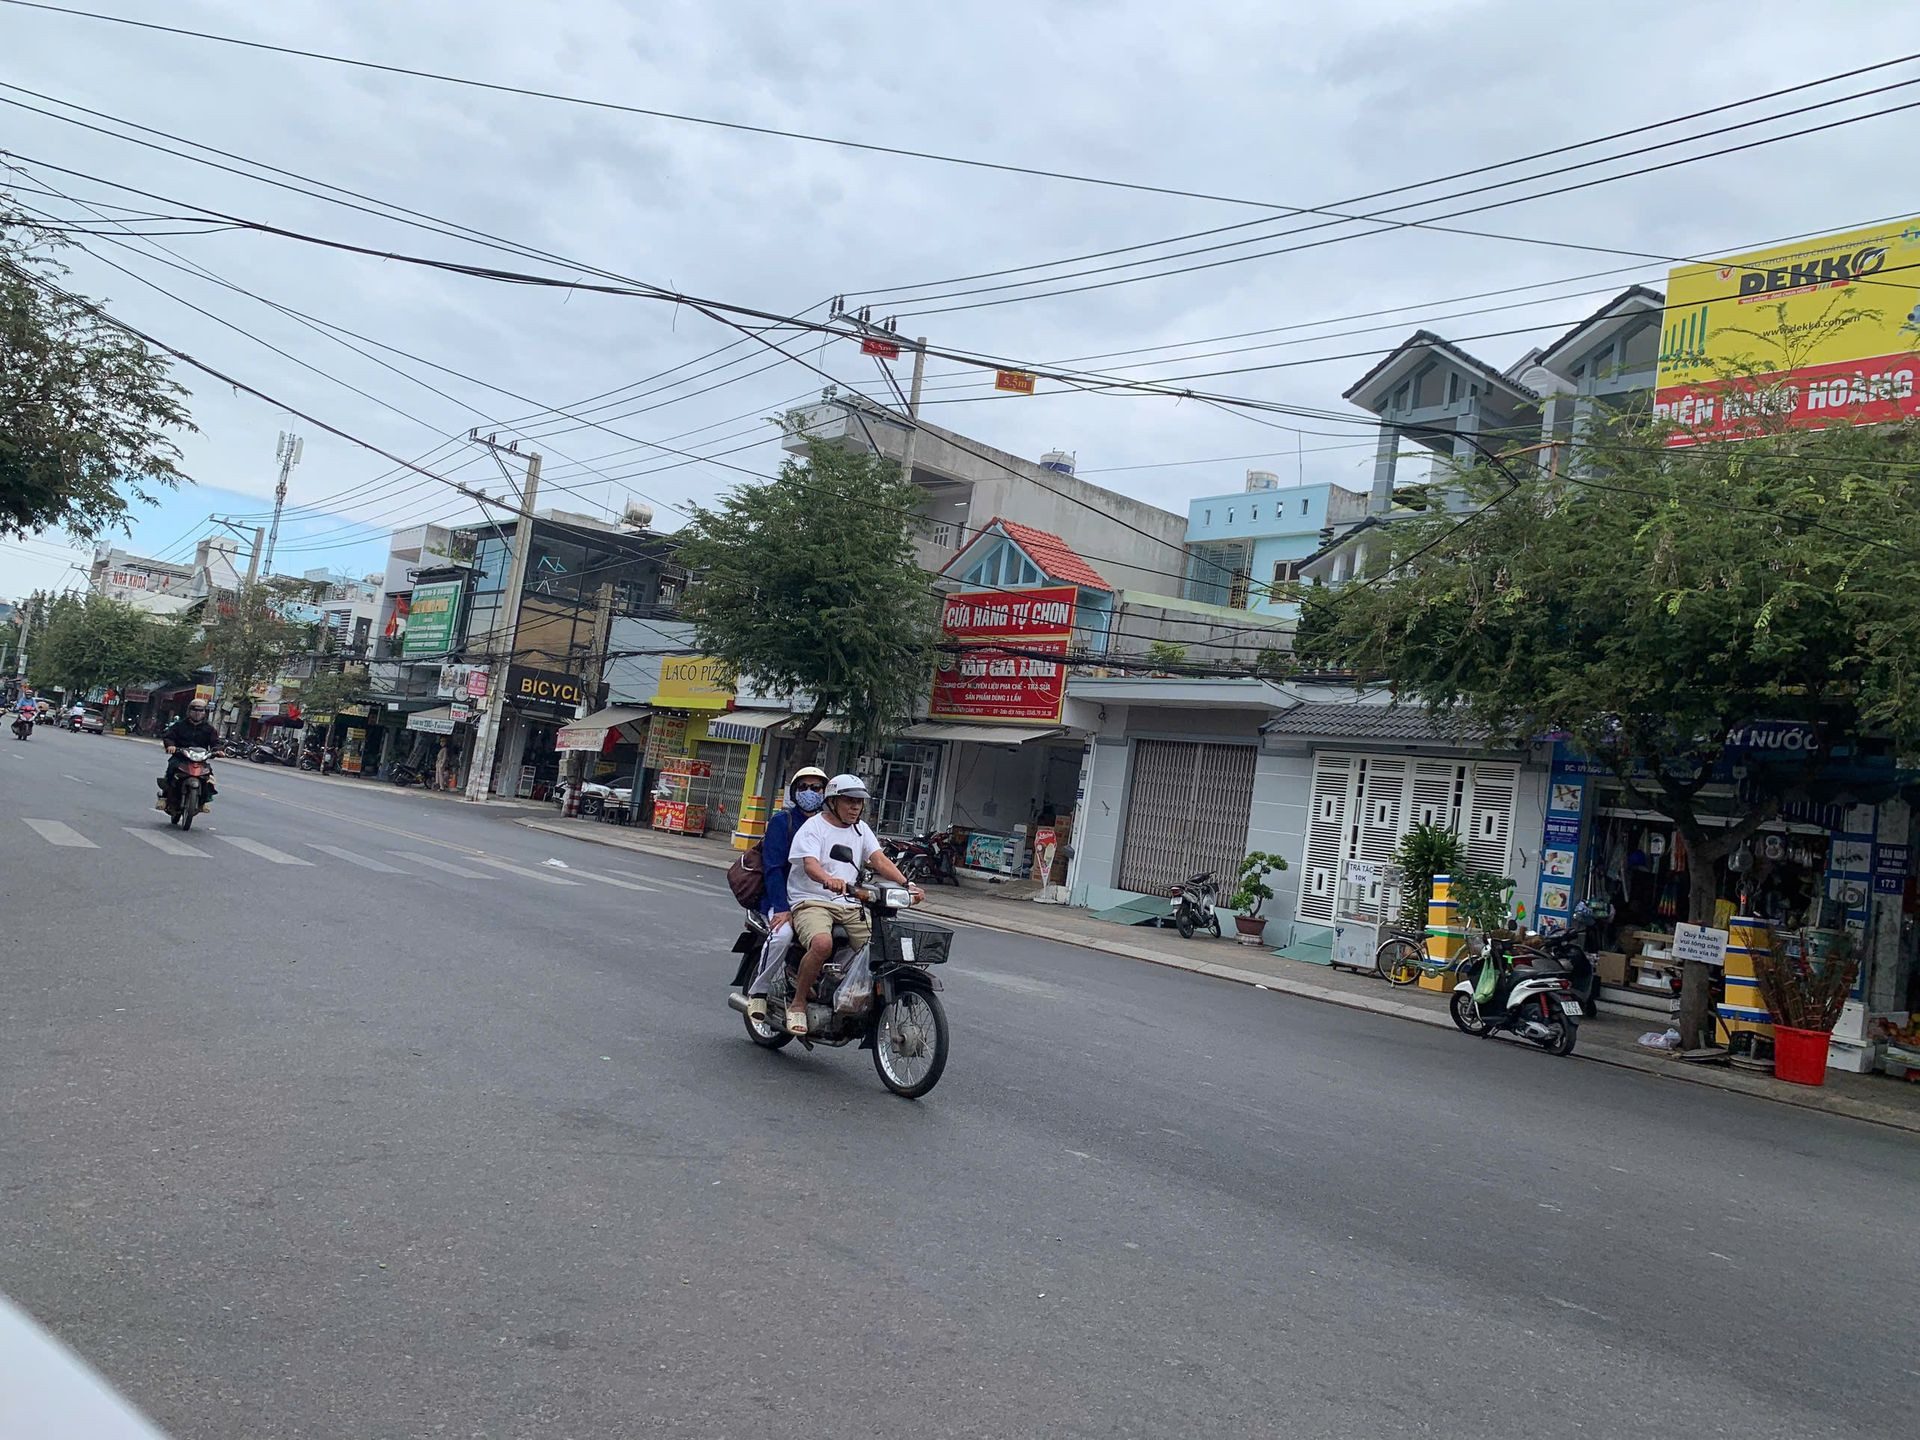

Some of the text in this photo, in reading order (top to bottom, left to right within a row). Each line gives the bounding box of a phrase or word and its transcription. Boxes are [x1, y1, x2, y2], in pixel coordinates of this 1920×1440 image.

[1739, 247, 1891, 295] DEKKO
[129, 574, 147, 589] KHOA
[946, 600, 1070, 630] CỬA HÀNG TỰ CHỌN
[666, 664, 728, 681] LACO PIZZ
[989, 659, 1016, 677] GIA
[1018, 659, 1057, 677] LINH
[521, 678, 582, 702] BICYCL
[1749, 728, 1819, 750] NƯỚC
[1355, 874, 1367, 882] 10K
[1881, 879, 1896, 889] 173
[1698, 933, 1718, 942] khách
